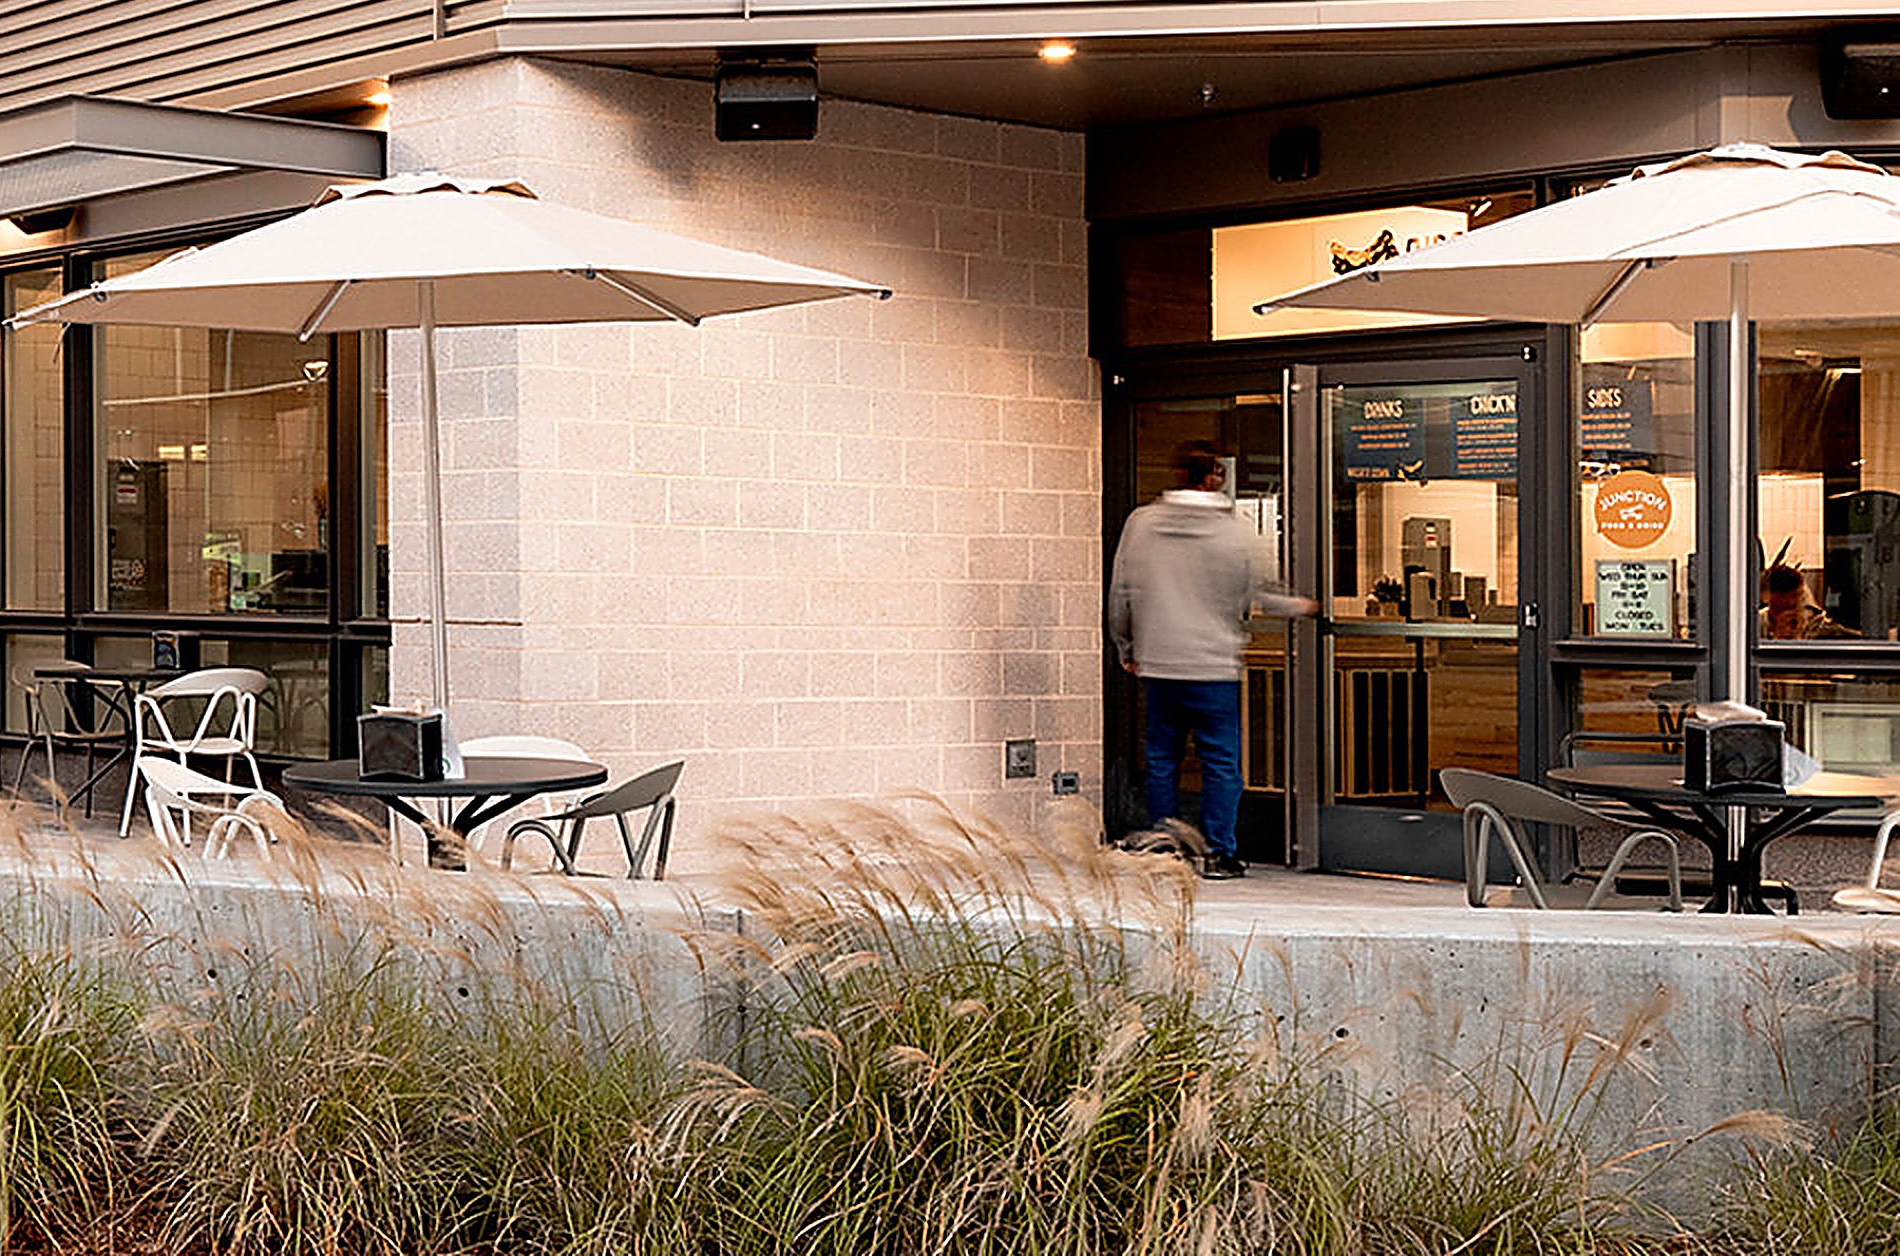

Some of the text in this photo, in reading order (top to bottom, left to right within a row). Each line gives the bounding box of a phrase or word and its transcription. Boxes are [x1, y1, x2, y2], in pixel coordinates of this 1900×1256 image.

[1587, 388, 1622, 408] SIDES
[1364, 400, 1403, 419] DRINKS
[1599, 490, 1667, 511] JUNCTION
[1621, 563, 1646, 572] OPEN
[1598, 572, 1620, 581] WED
[1631, 591, 1648, 600] SAT
[1615, 611, 1653, 620] CLOSED
[1605, 622, 1629, 630] MON
